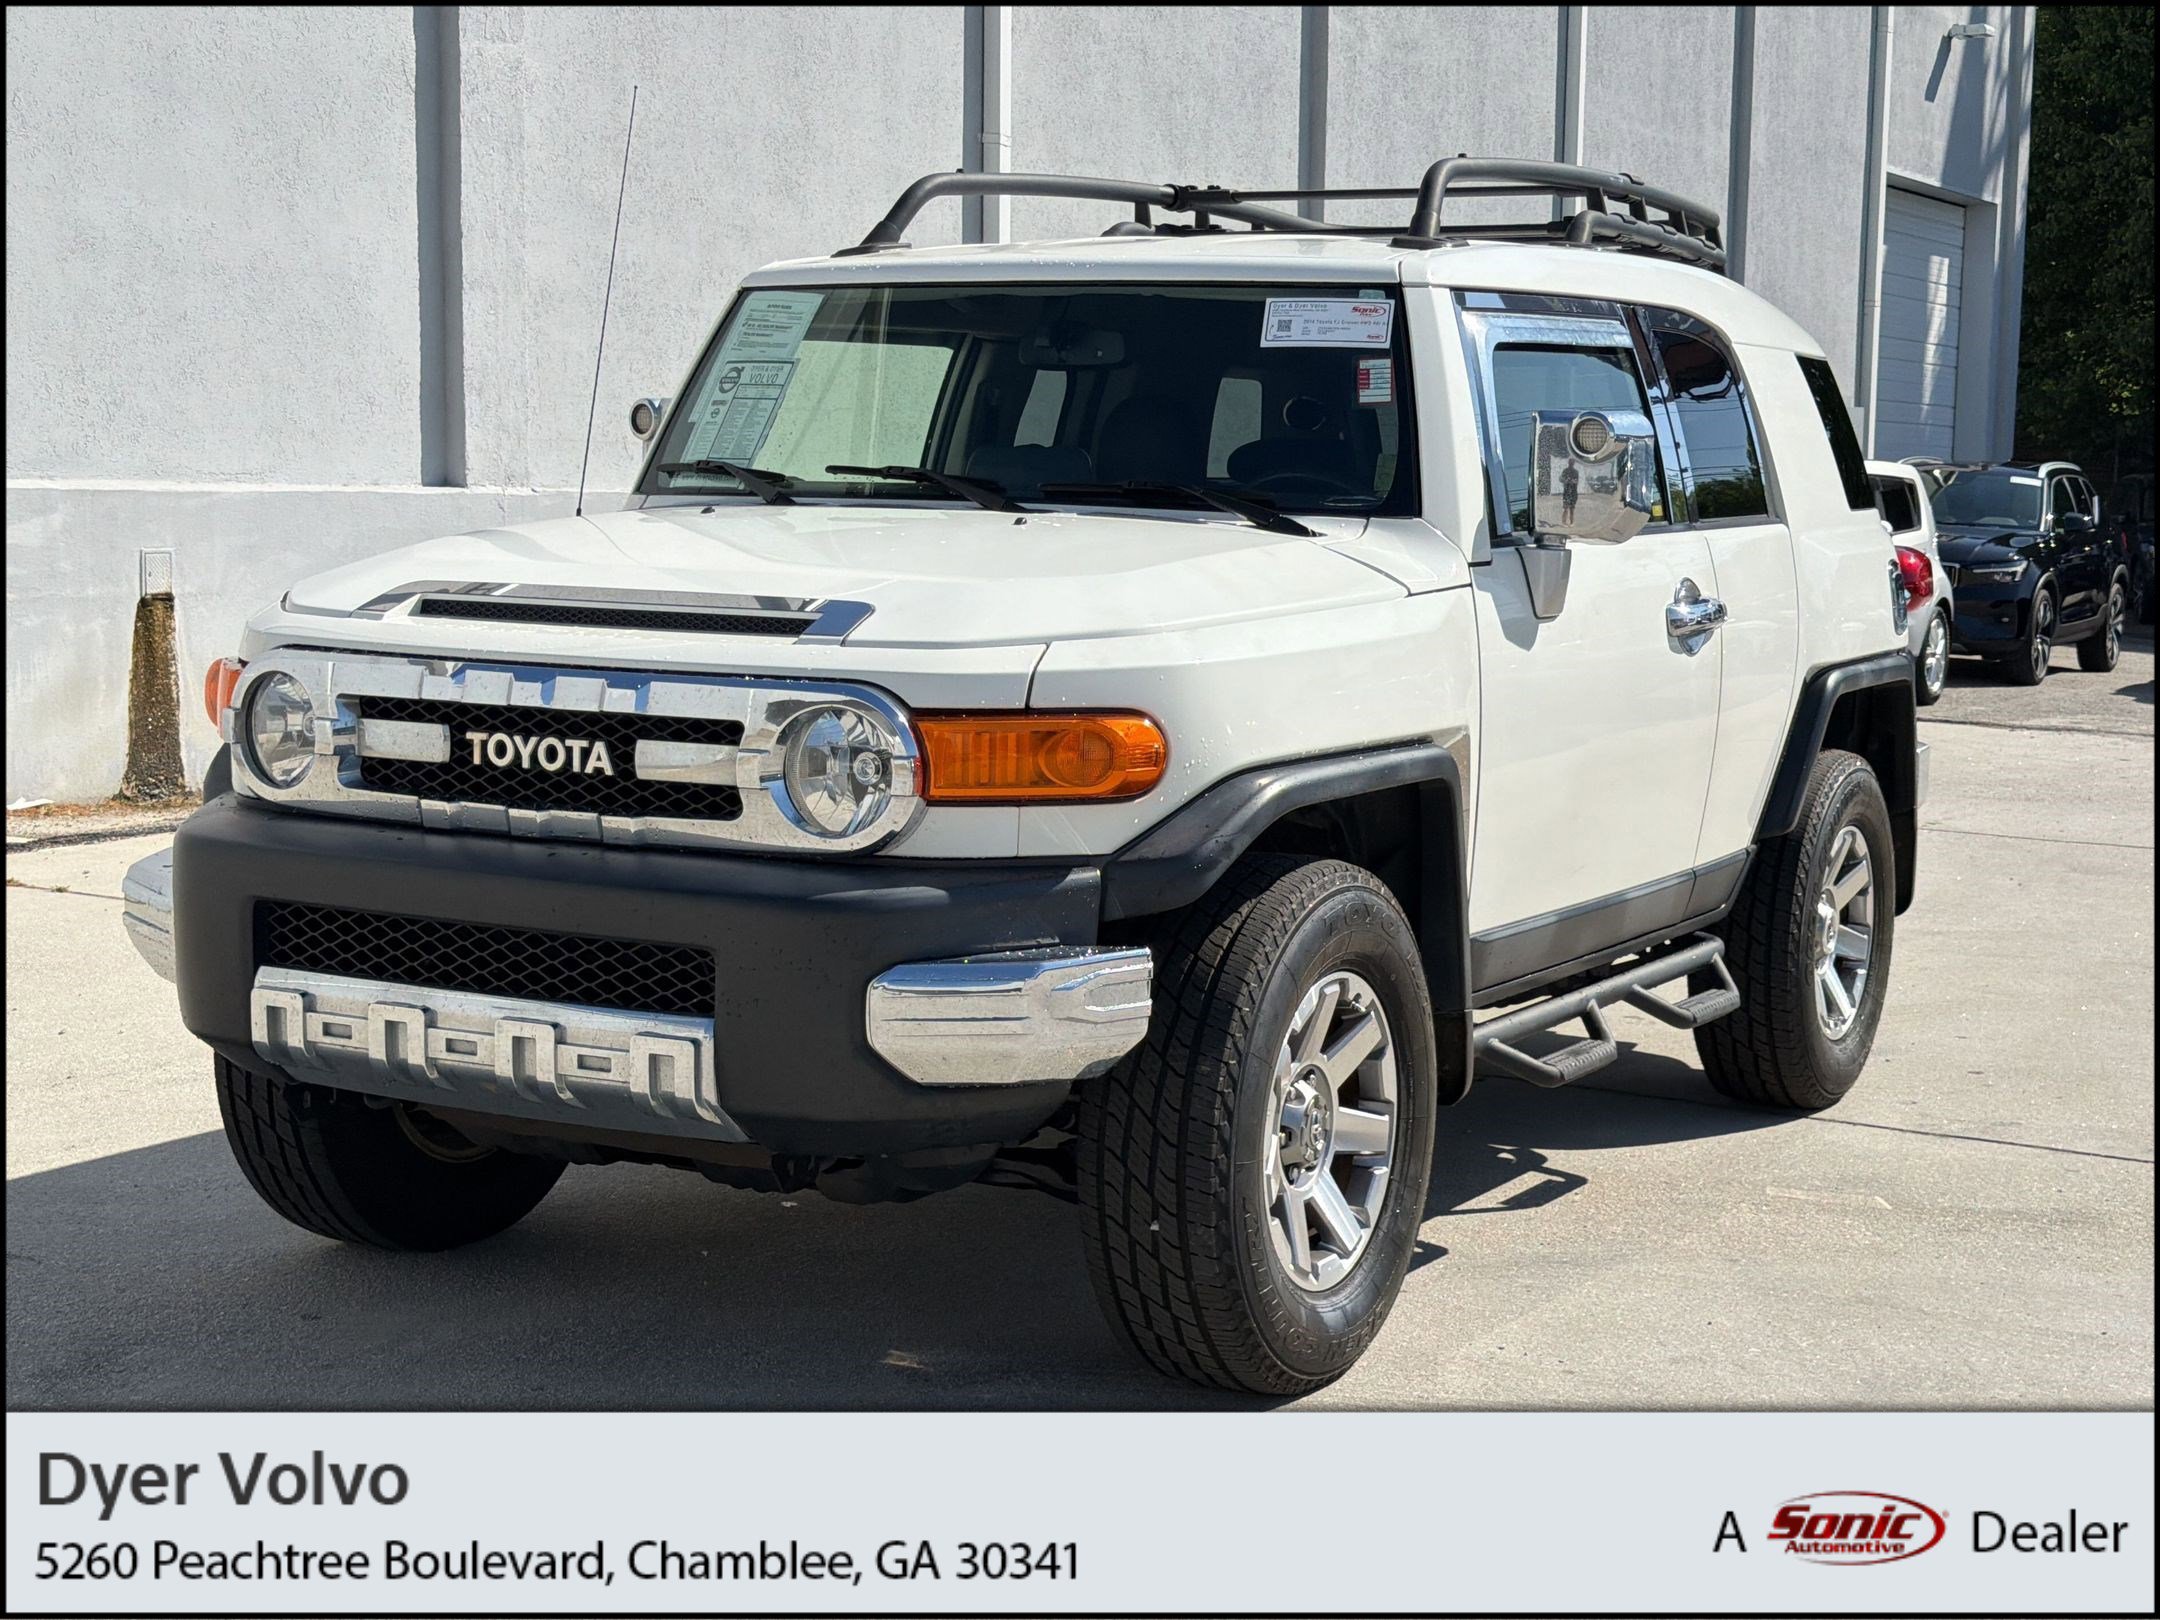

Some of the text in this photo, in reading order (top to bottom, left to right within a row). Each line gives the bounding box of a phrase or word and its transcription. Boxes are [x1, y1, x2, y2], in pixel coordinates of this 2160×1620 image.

[1351, 305, 1381, 314] Sonic
[750, 373, 779, 384] VOLVO
[465, 731, 614, 776] TOYOTA
[1323, 901, 1401, 938] TOYO
